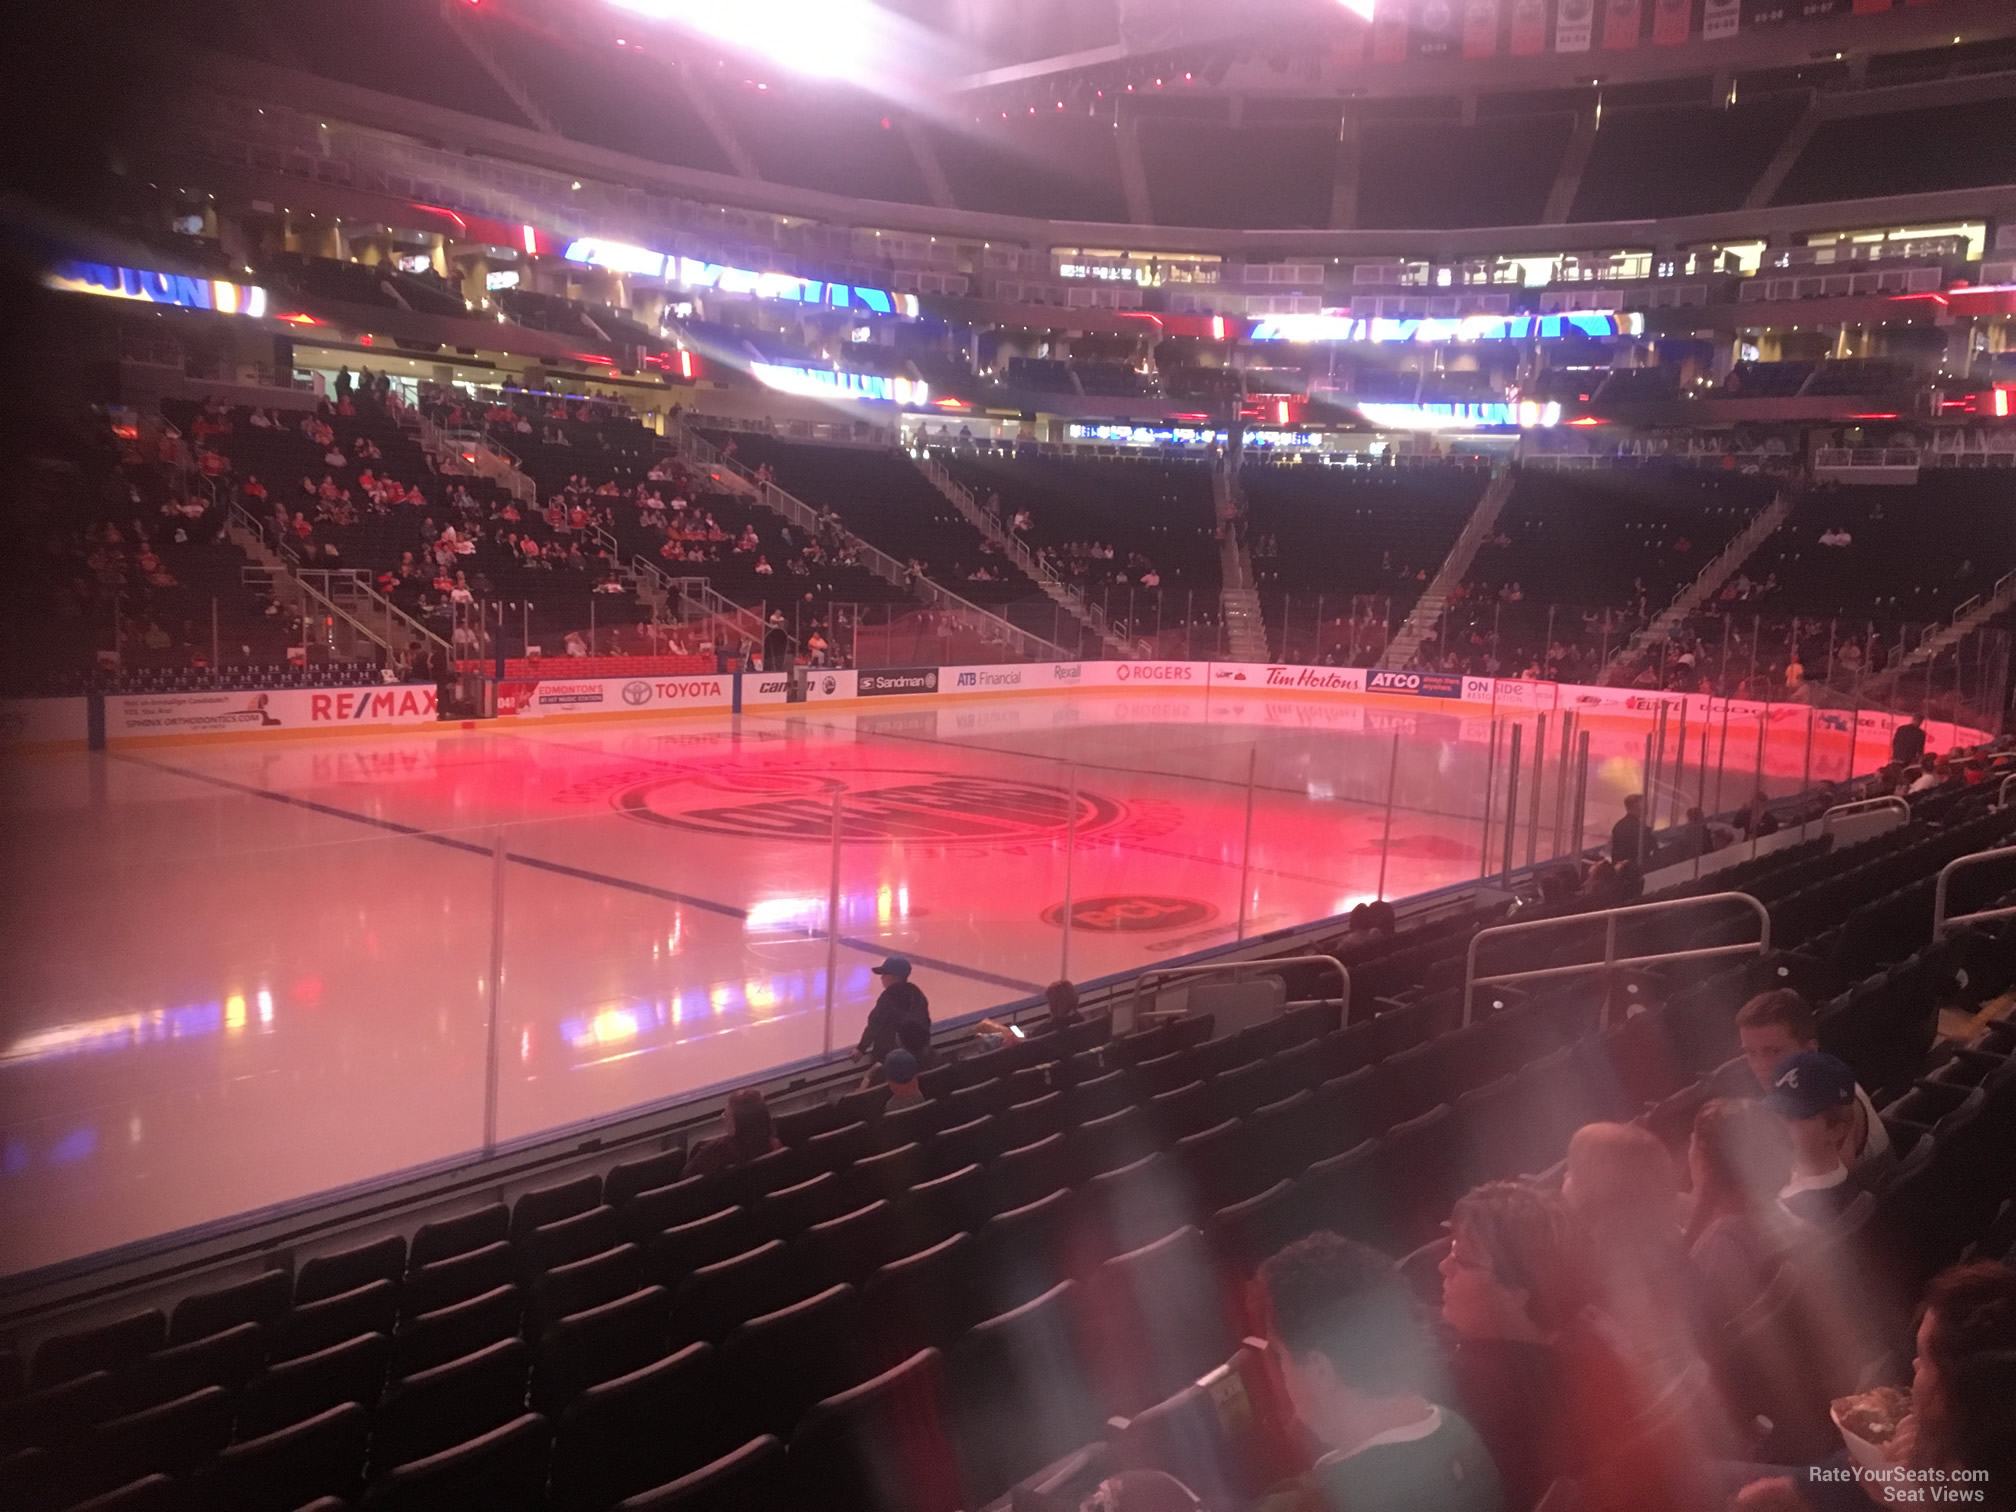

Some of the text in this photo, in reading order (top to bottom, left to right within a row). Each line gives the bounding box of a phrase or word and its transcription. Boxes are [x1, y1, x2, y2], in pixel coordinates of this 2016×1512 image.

[957, 671, 1021, 686] ATB Financial
[1054, 665, 1081, 679] Rexall
[1133, 666, 1192, 680] ROGERS
[1266, 667, 1359, 689] Tim Hortons
[876, 676, 924, 689] Sandman
[1371, 672, 1420, 688] ATCO
[539, 685, 603, 695] EDMONTON'S
[655, 682, 721, 699] TOYOTA
[312, 690, 437, 721] RE/MAX
